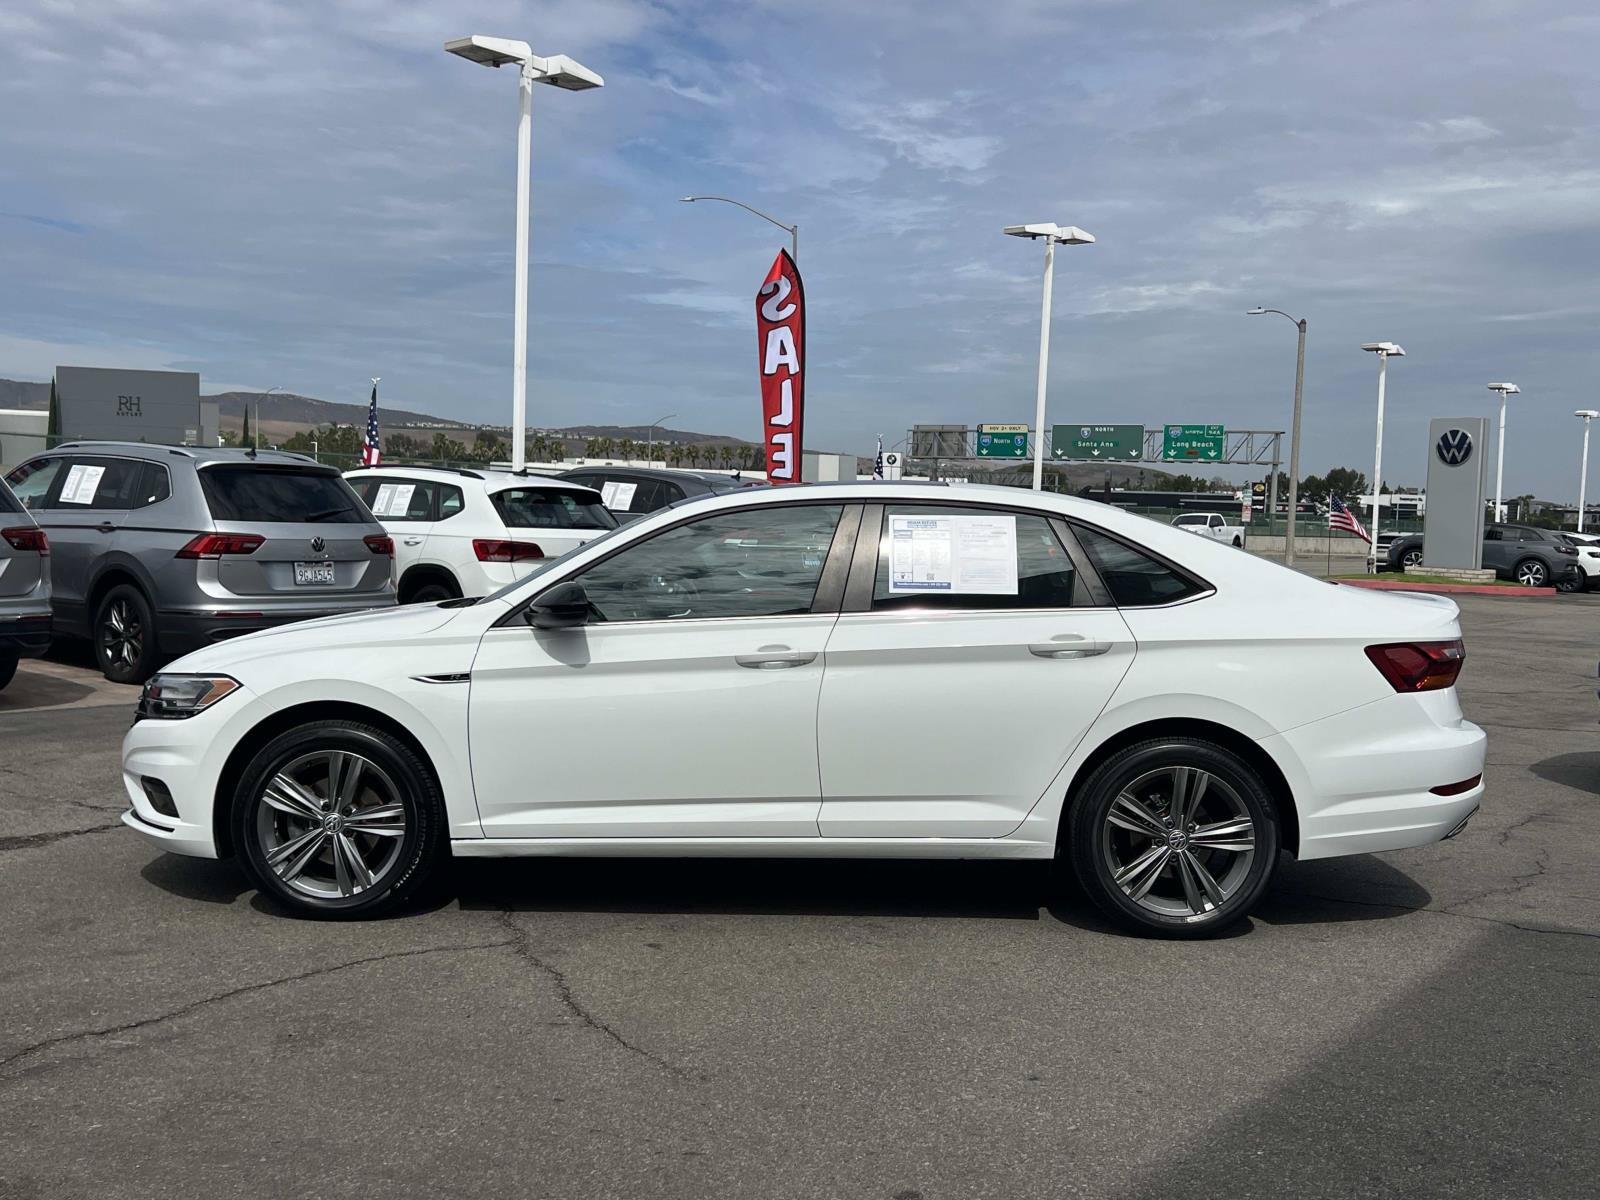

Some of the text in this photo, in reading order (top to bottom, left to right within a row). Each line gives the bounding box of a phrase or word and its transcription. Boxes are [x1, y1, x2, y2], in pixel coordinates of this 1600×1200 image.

[117, 395, 141, 411] RH
[1077, 440, 1114, 448] Santa Ana
[1171, 441, 1189, 449] Long
